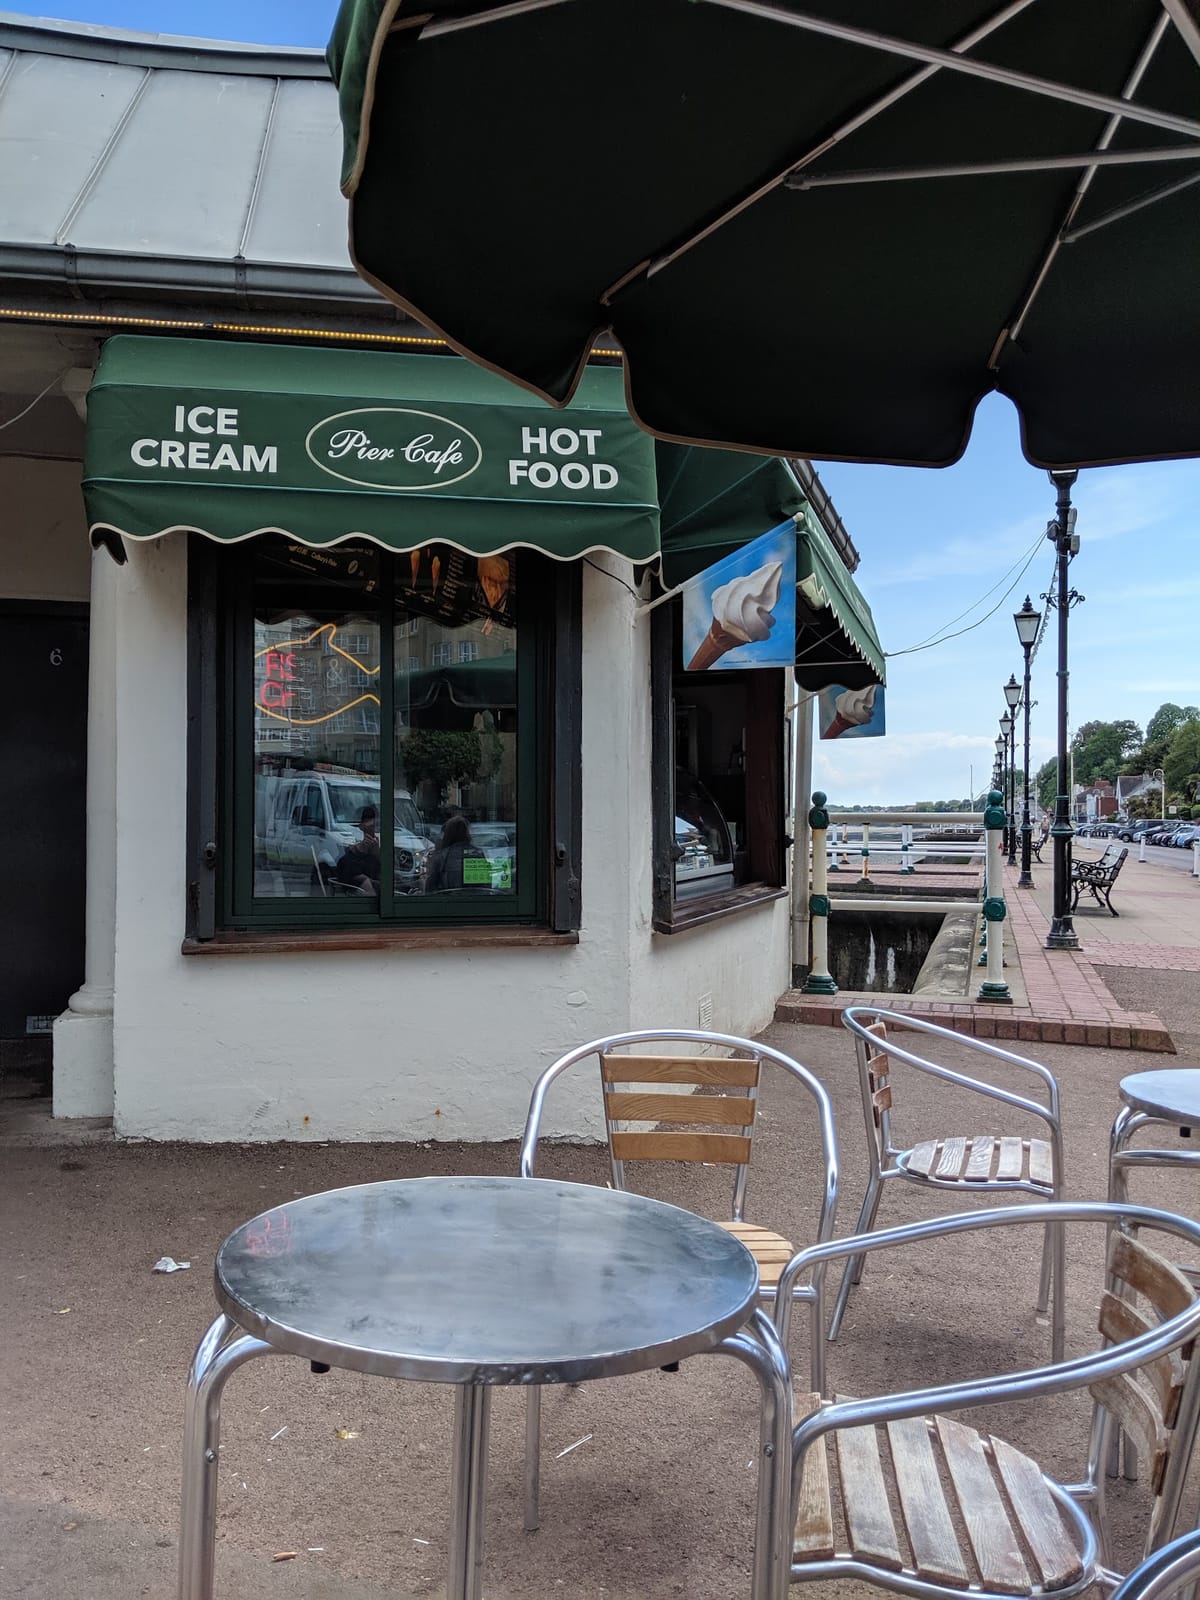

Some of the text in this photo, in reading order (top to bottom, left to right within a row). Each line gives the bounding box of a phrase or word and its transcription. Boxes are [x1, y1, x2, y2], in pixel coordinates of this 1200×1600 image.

[174, 405, 239, 436] ICE
[130, 438, 278, 473] CREAM
[327, 429, 463, 474] Pier Cafe
[521, 426, 602, 456] HOT
[508, 459, 619, 490] FOOD
[49, 647, 64, 667] 6
